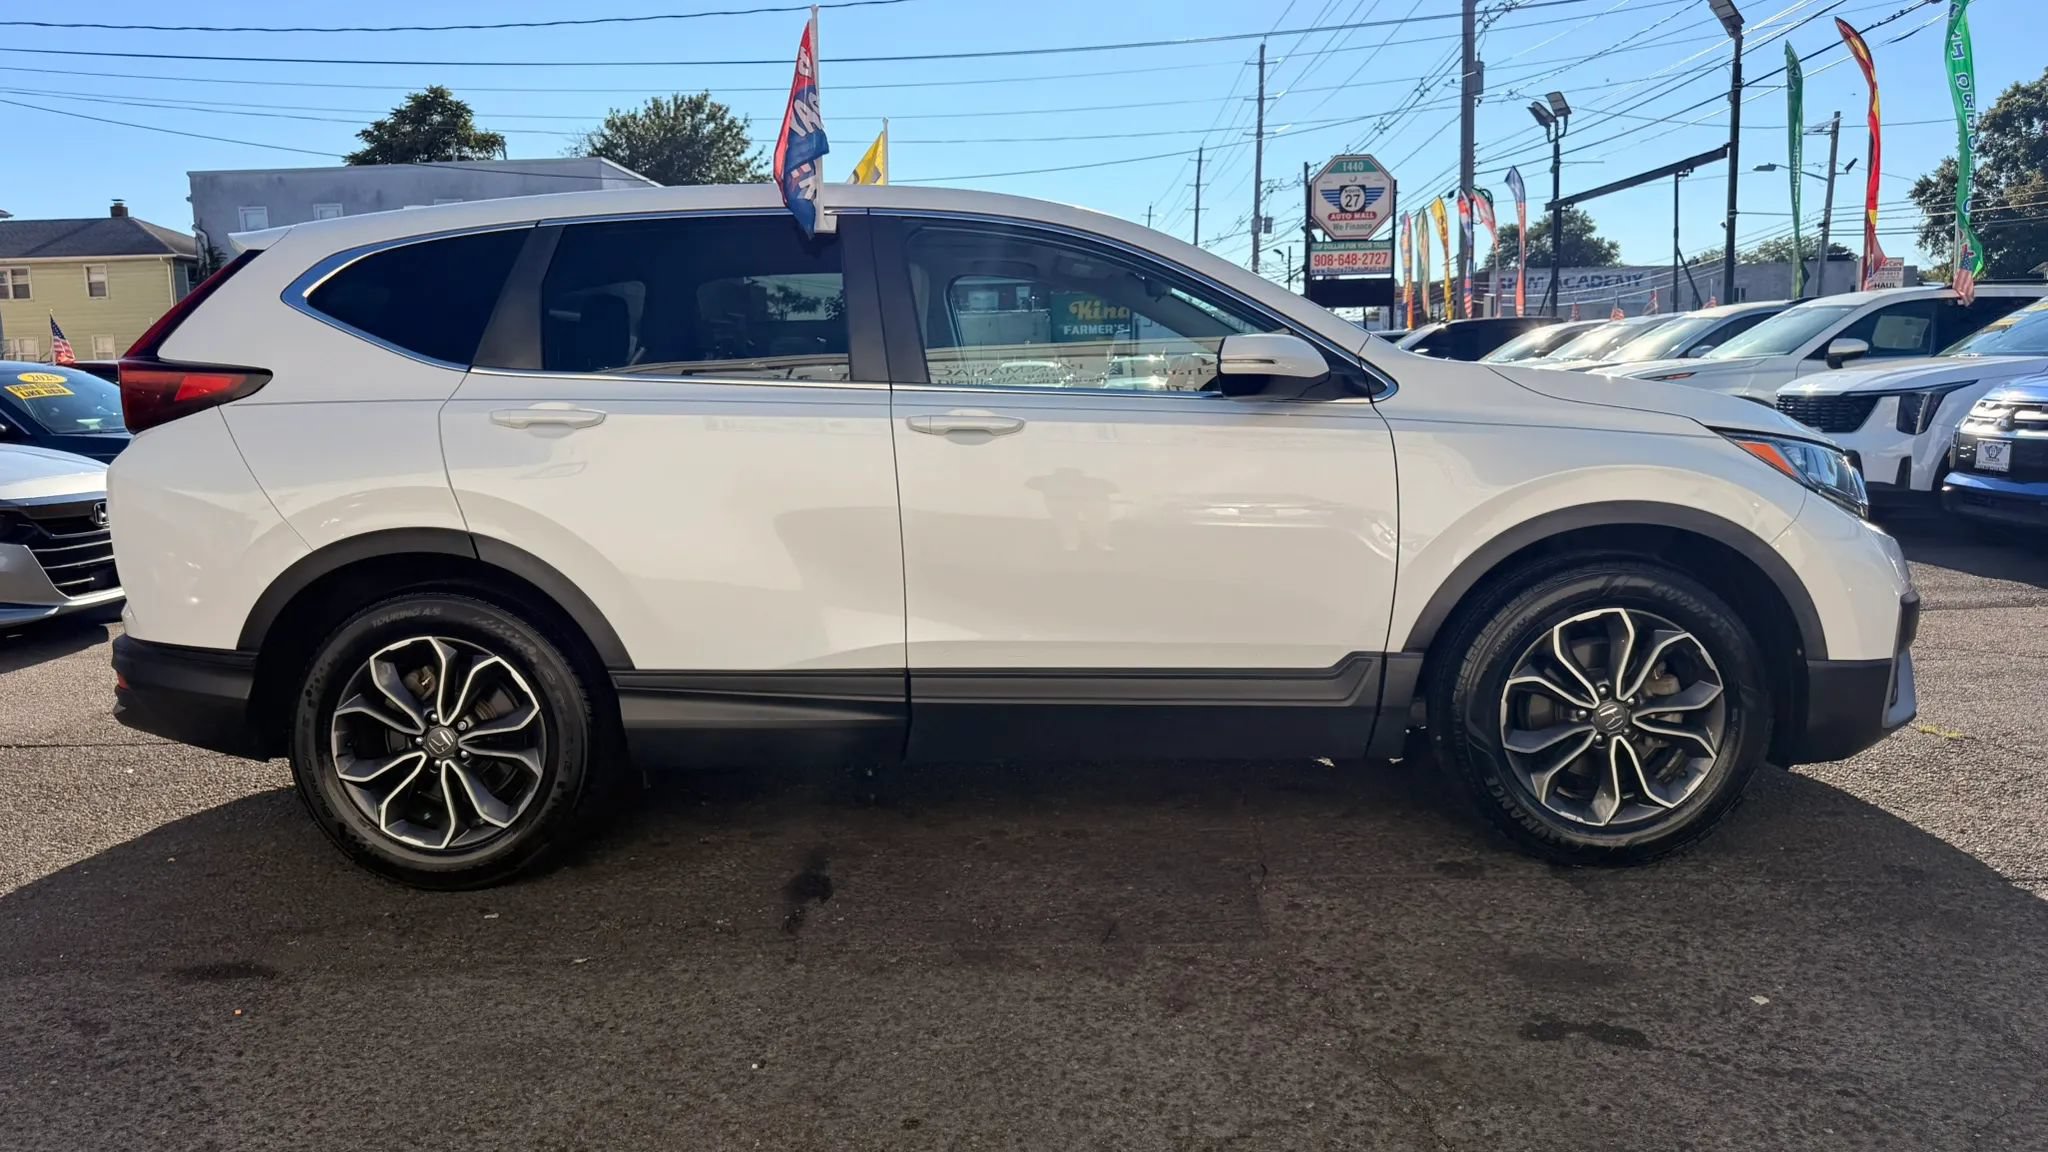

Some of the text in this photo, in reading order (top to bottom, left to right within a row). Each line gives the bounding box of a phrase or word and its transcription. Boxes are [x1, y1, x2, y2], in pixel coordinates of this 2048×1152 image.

[1342, 162, 1364, 171] 1440
[1344, 194, 1360, 208] 27
[1345, 222, 1373, 230] Finance
[1314, 252, 1388, 266] 908-648-2727
